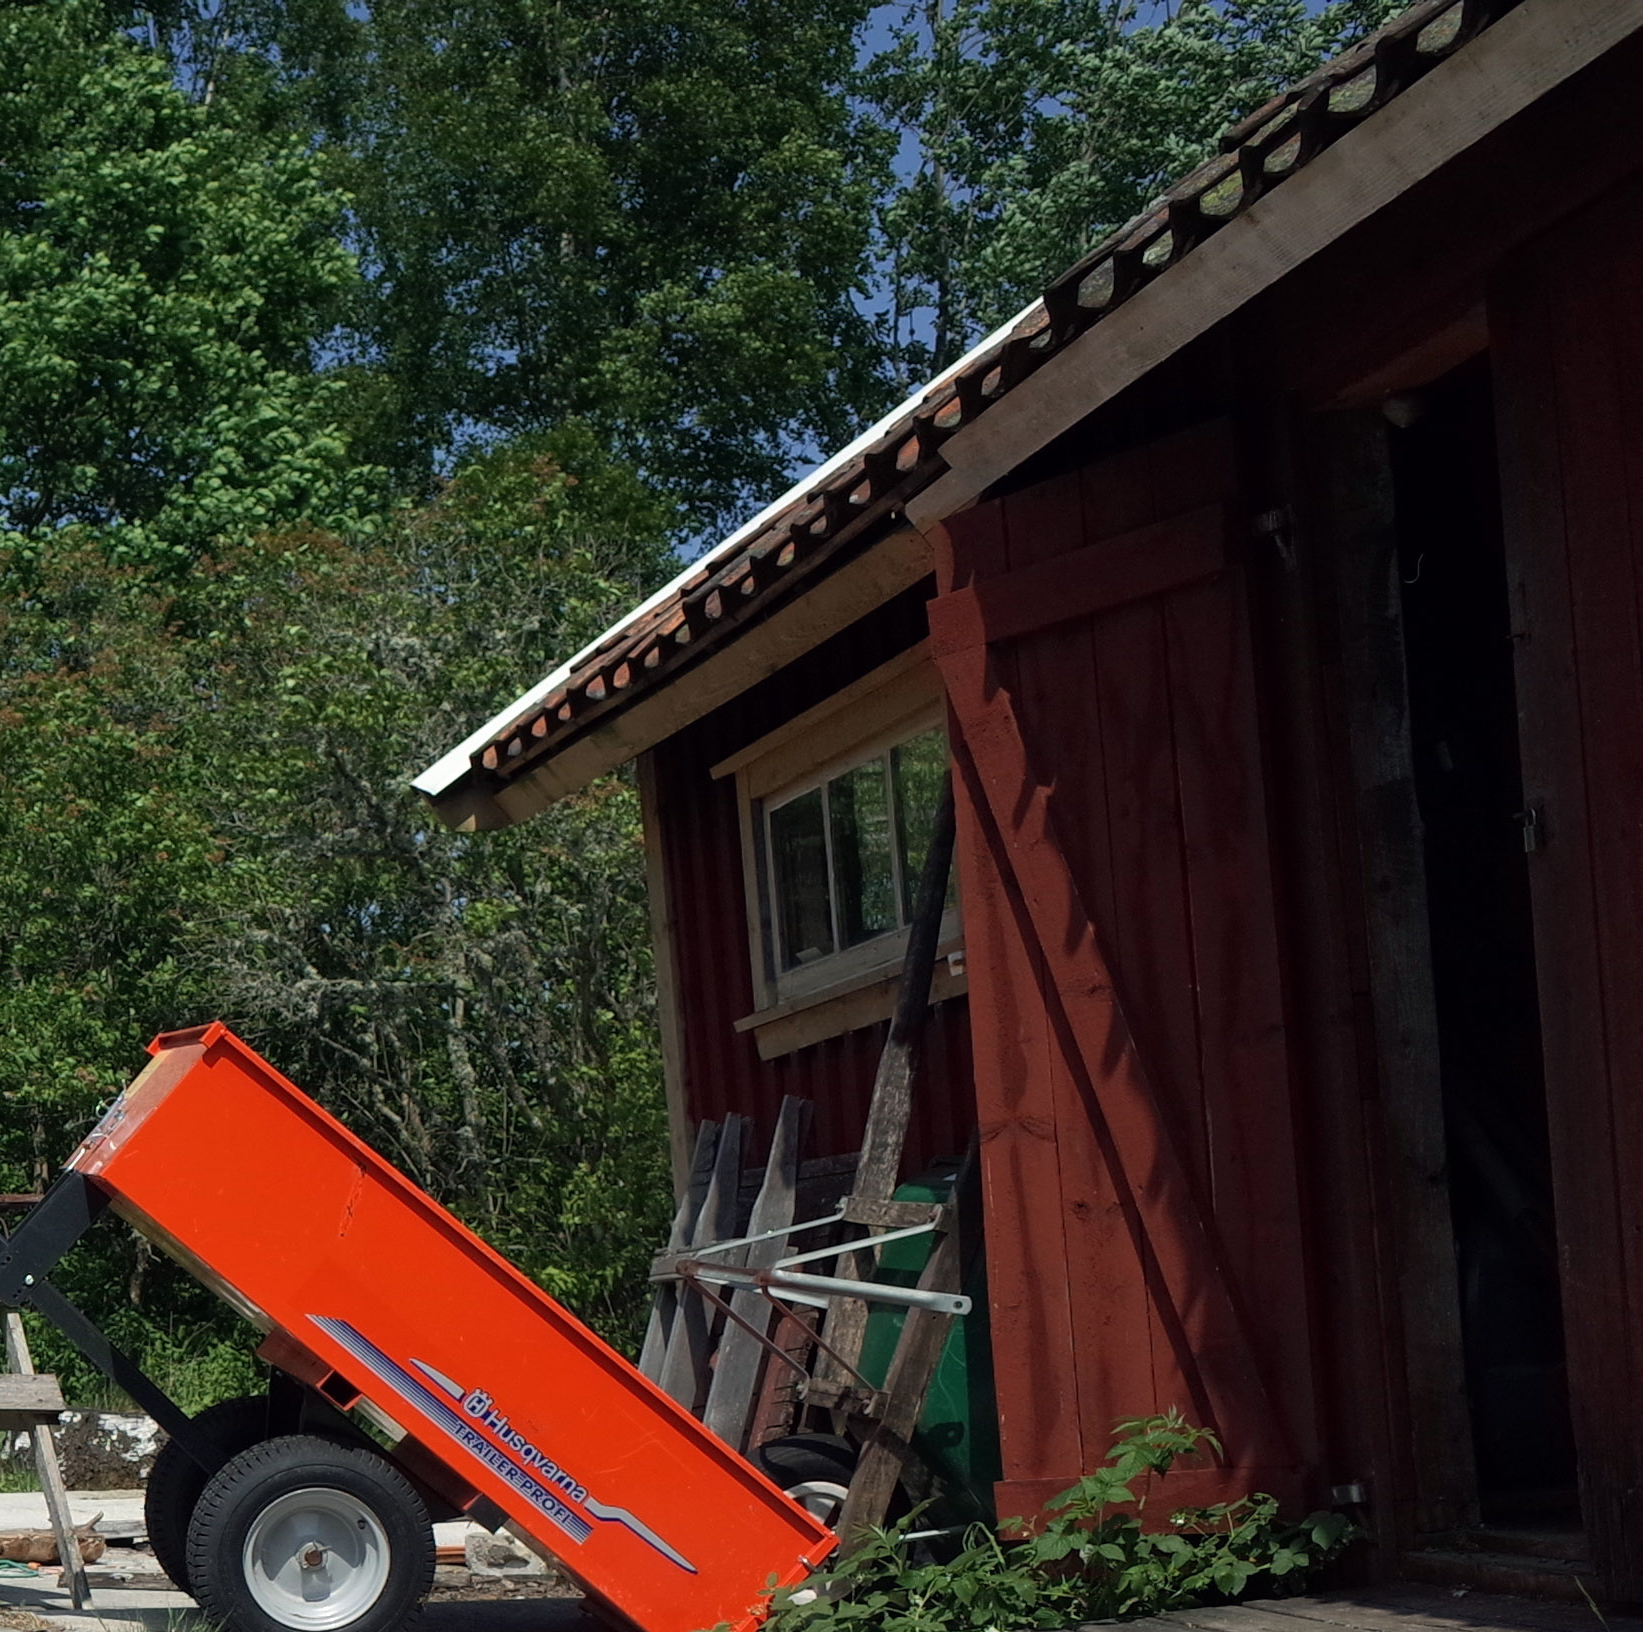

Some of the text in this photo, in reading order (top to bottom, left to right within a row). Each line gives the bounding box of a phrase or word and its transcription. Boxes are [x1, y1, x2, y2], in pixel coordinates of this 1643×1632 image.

[453, 1421, 571, 1524] TRAILER PROFI
[483, 1408, 588, 1504] Husqvarna
